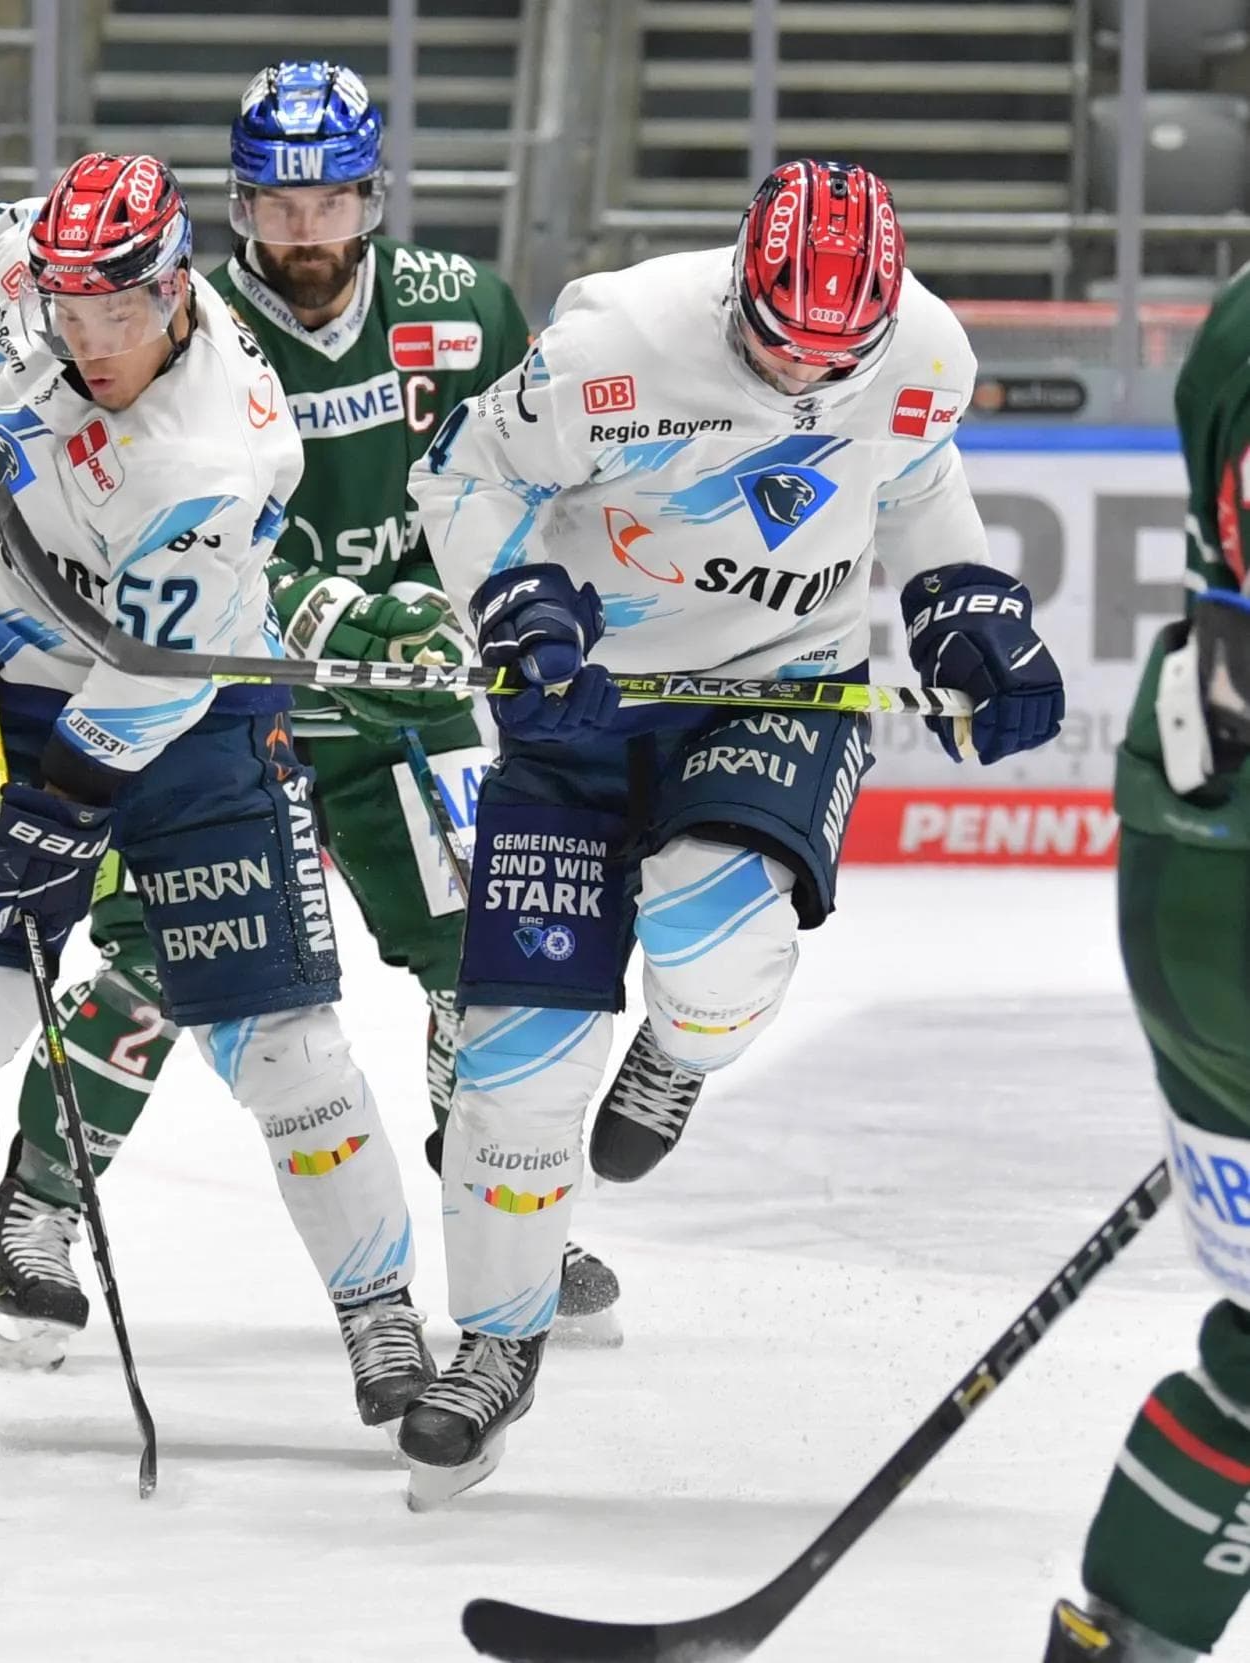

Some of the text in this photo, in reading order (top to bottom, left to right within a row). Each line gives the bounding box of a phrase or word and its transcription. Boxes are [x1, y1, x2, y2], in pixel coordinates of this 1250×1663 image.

[275, 148, 324, 180] LEW
[392, 247, 478, 279] AHA
[824, 275, 839, 296] 4
[406, 374, 436, 433] C
[589, 378, 630, 410] DB
[590, 418, 734, 444] Regio Bayern
[116, 571, 199, 650] 52
[313, 661, 490, 691] CCM
[681, 744, 798, 788] BRÄU
[492, 832, 607, 858] GEMEINSAM
[283, 776, 335, 953] SATURN
[489, 854, 606, 883] SIND WIR
[144, 856, 271, 906] HERRN
[485, 879, 603, 918] STARK
[519, 916, 544, 926] ERC
[22, 914, 47, 979] BAUER
[161, 914, 268, 962] BRÄU
[109, 1003, 166, 1078] 2
[333, 1271, 399, 1301] BAUER
